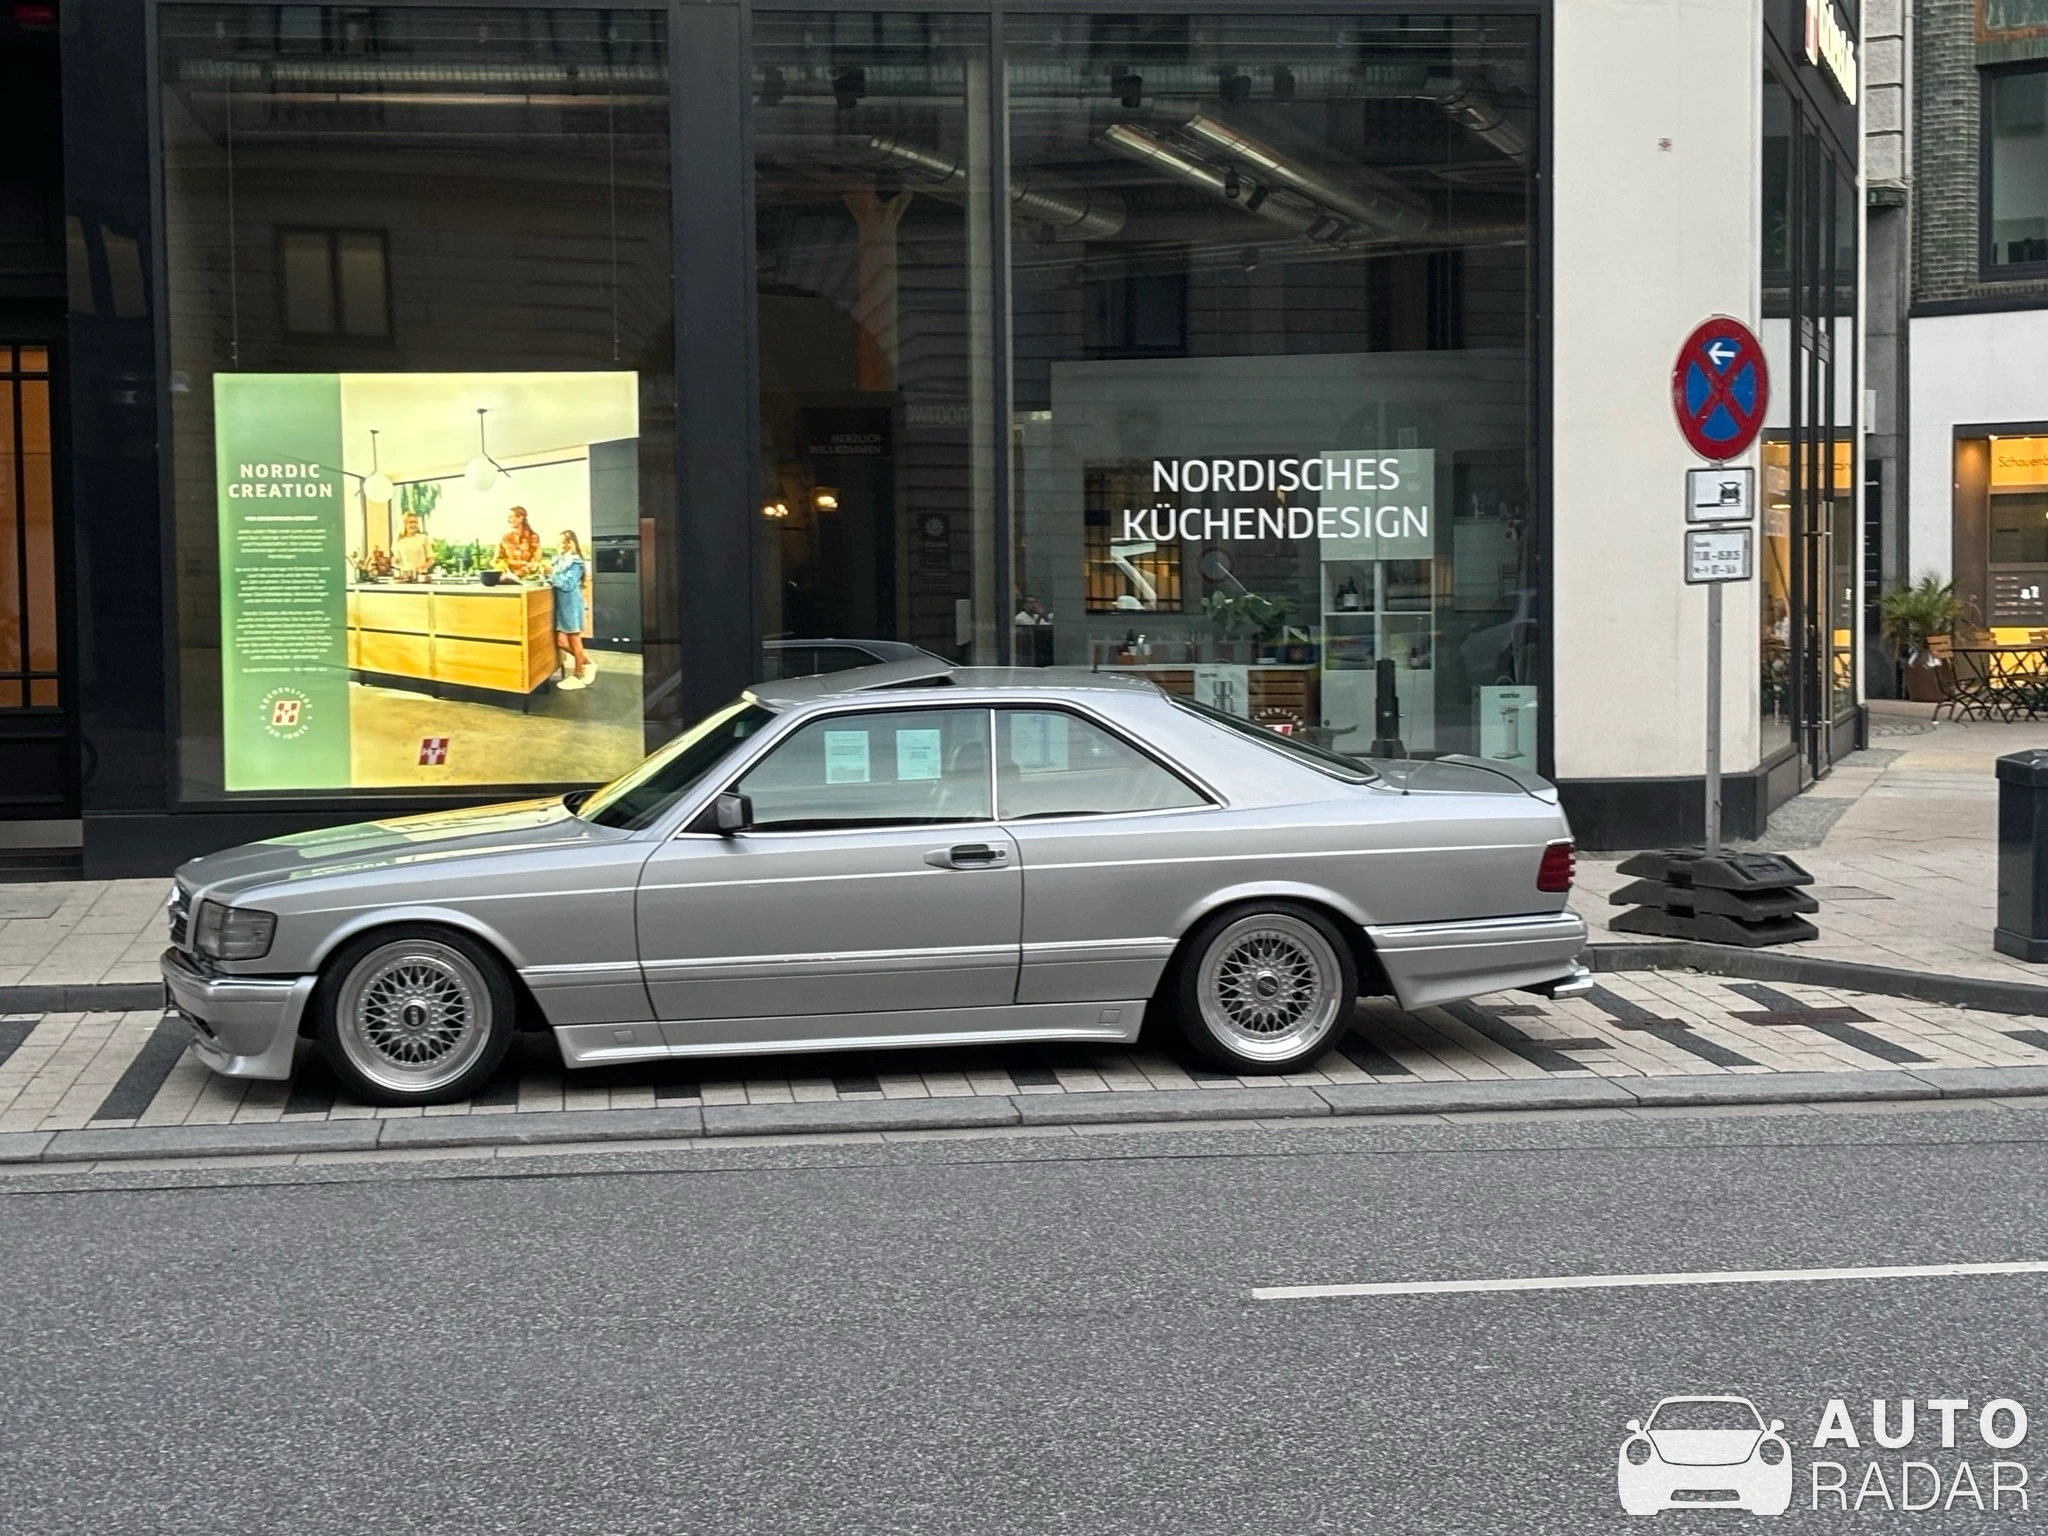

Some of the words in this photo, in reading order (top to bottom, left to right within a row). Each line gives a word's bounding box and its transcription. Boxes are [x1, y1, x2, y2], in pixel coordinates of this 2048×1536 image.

[240, 463, 320, 478] NORDIC
[1153, 458, 1400, 492] NORDISCHES
[228, 483, 333, 498] CREATION
[1123, 504, 1428, 541] KÜCHENDESIGN
